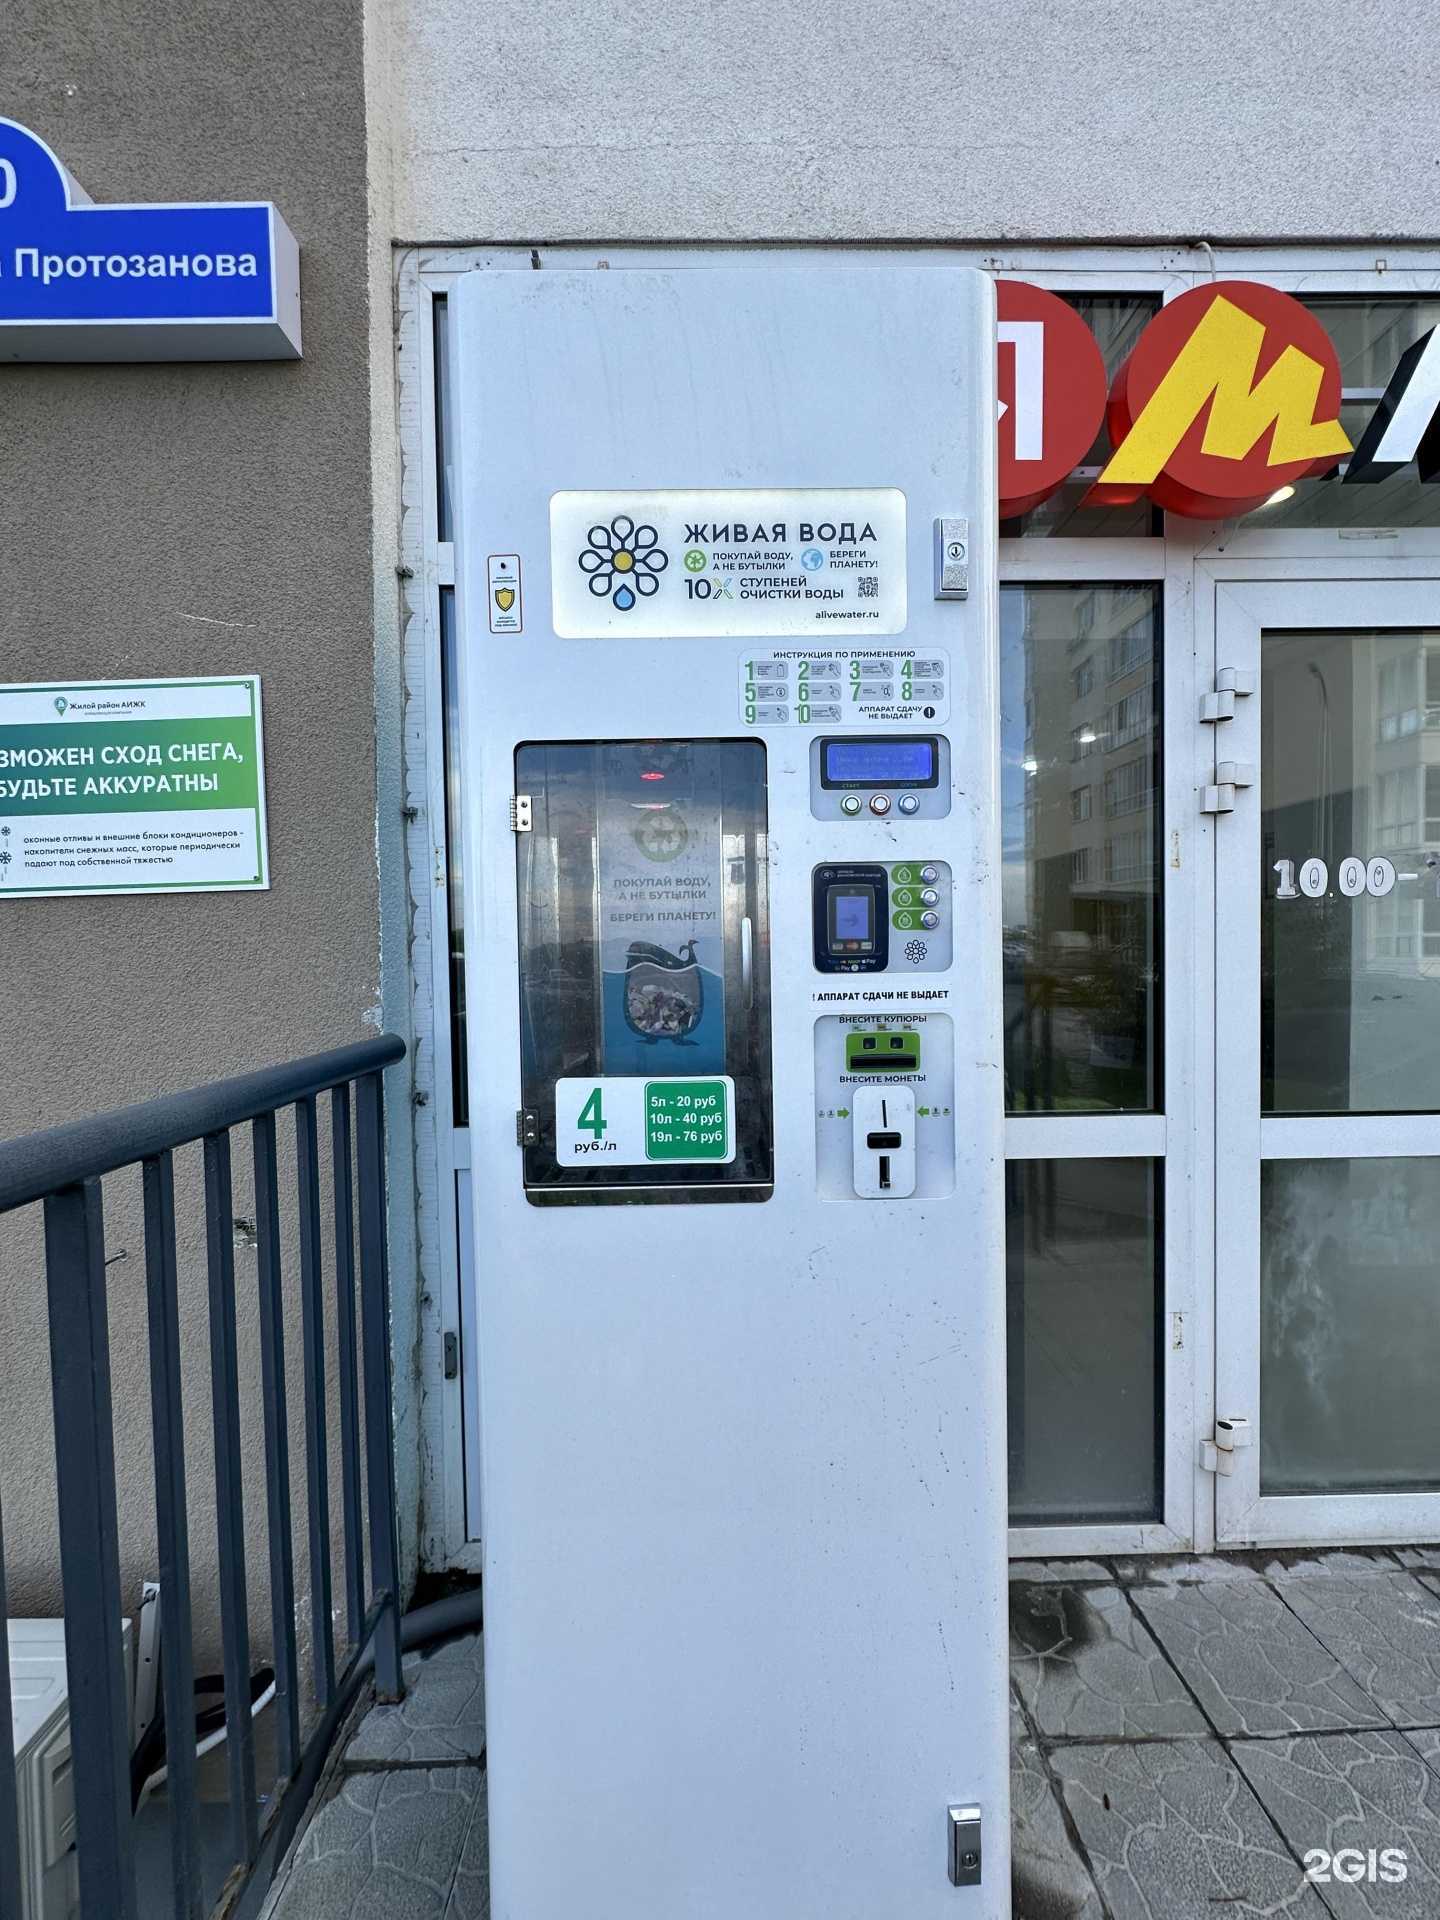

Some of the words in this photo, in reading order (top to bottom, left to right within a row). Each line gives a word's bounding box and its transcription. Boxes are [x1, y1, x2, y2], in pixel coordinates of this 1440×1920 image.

[15, 248, 258, 285] Протозанова
[684, 523, 787, 543] ЖИВАЯ
[799, 522, 878, 545] ВОДА
[712, 551, 761, 560] ПОКУПАЙ
[764, 552, 793, 560] ВОДУ,
[830, 550, 867, 558] БЕРЕГИ
[738, 562, 785, 570] БУТЫЛКИ
[830, 560, 878, 568] ПЛАНЕТУ!
[739, 576, 807, 588] СТУПЕНЕЙ
[739, 589, 801, 600] ОЧИСТКИ
[805, 589, 844, 600] ВОДЫ
[815, 610, 879, 619] alivewater.ru
[773, 651, 833, 659] ИНСТРУКЦИЯ
[835, 651, 849, 659] ПО
[850, 650, 916, 658] ПРИМЕНЕНИЮ
[744, 660, 754, 681] 1
[797, 660, 810, 681] 2
[849, 660, 861, 680] 3
[900, 659, 913, 680] 4
[744, 682, 757, 702] 5
[798, 682, 810, 702] 6
[849, 681, 862, 702] 7
[901, 681, 913, 701] 8
[97, 702, 120, 710] район
[121, 700, 147, 708] АИЖК
[896, 705, 923, 713] СДАЧУ
[745, 704, 757, 725] 9
[793, 703, 811, 724] 10
[101, 745, 163, 766] СХОД
[168, 742, 244, 764] СНЕГА,
[83, 773, 219, 796] АККУРАТНЫ
[24, 836, 61, 844] оконные
[63, 834, 93, 842] отливы
[103, 833, 141, 841] внешние
[143, 831, 169, 840] блоки
[170, 830, 238, 839] кондиционеров
[25, 848, 75, 856] накопители
[77, 846, 114, 854] снежных
[117, 845, 139, 853] масс,
[141, 844, 178, 853] которые
[179, 842, 241, 852] периодически
[25, 860, 57, 868] падают
[60, 859, 76, 868] под
[77, 857, 132, 867] собственной
[133, 856, 174, 864] тяжестью
[614, 876, 672, 888] ПОКУПАЙ
[675, 875, 712, 887] ВОДУ,
[618, 892, 627, 901] А
[630, 892, 646, 900] НЕ
[648, 890, 707, 900] БУТЫЛКИ
[609, 912, 655, 922] БЕРЕГИ
[657, 911, 716, 921] ПЛАНЕТУ!
[817, 992, 860, 1001] АППАРАТ
[862, 991, 894, 1000] СДАЧИ
[896, 991, 909, 999] НЕ
[911, 990, 949, 1000] ВЫДАЕТ
[839, 1016, 881, 1024] ВНЕСИТЕ
[884, 1015, 927, 1023] КУПЮРЫ
[839, 1075, 882, 1083] ВНЕСИТЕ
[884, 1074, 927, 1083] МОНЕТЫ
[651, 1097, 667, 1107] 5л
[677, 1096, 691, 1107] 20
[694, 1095, 717, 1110] руб
[577, 1087, 607, 1140] 4
[650, 1113, 673, 1124] 10л
[683, 1112, 697, 1124] 40
[700, 1112, 722, 1128] руб
[650, 1132, 673, 1143] 19л
[683, 1131, 698, 1142] 76
[700, 1130, 723, 1145] руб
[574, 1140, 617, 1154] руб./л
